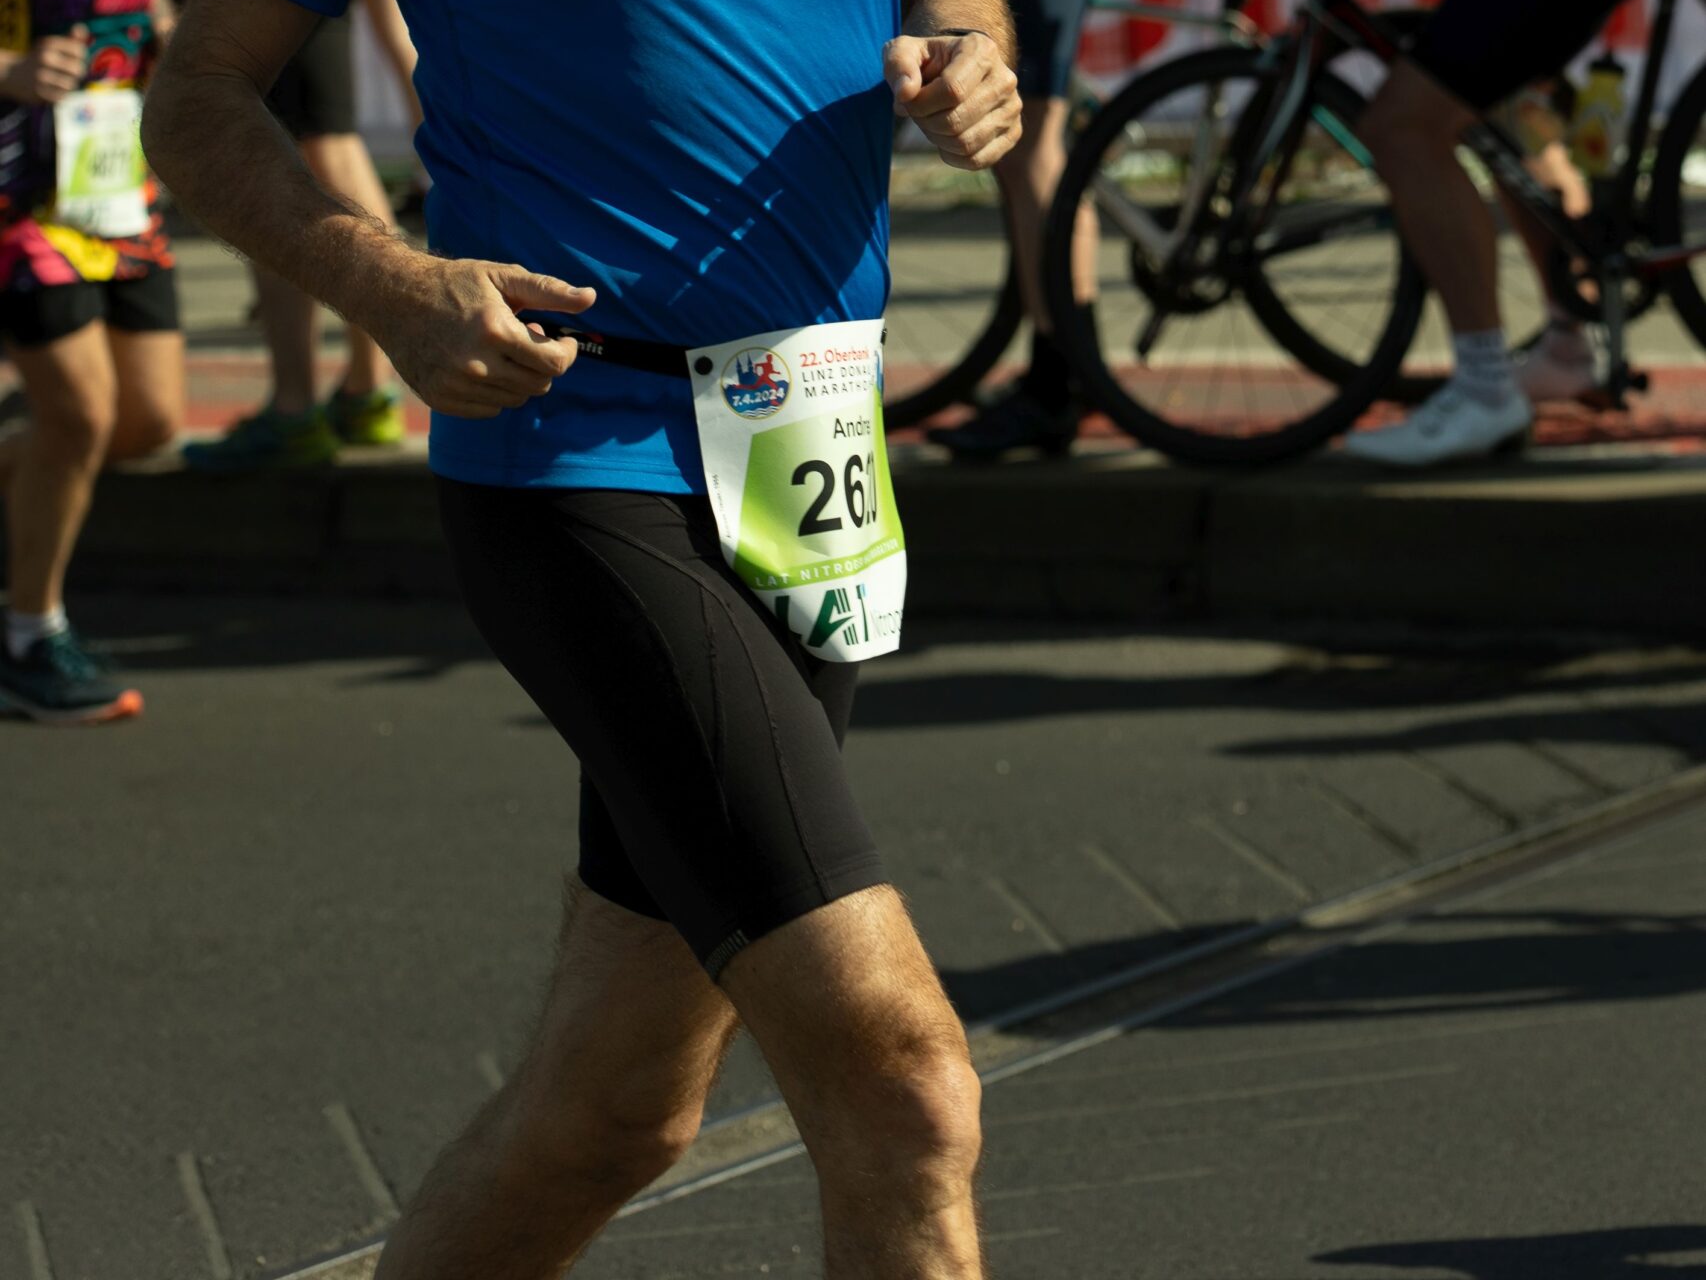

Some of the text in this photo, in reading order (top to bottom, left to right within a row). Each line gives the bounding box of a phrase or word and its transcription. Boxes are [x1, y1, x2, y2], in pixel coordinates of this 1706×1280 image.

[800, 351, 822, 368] 22.
[801, 368, 833, 383] LINZ
[732, 387, 786, 407] 7.4.2024
[755, 572, 790, 587] LAT
